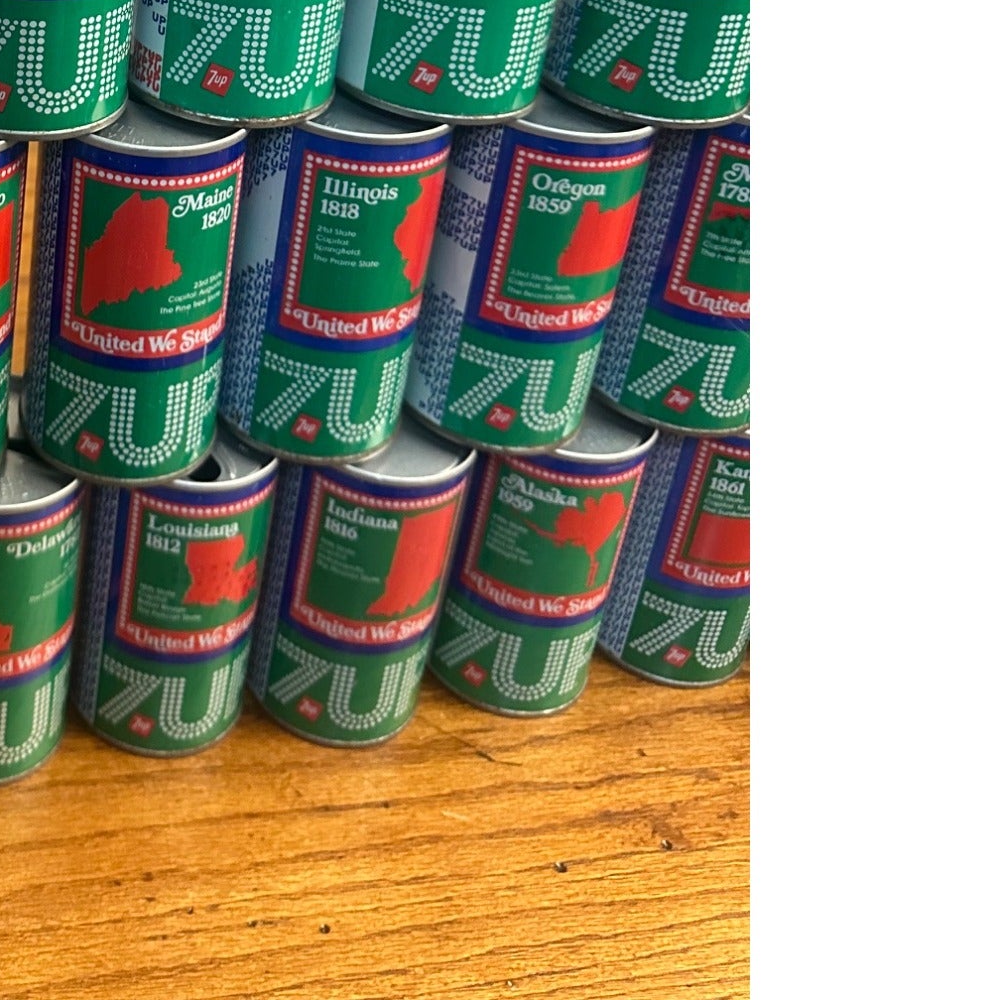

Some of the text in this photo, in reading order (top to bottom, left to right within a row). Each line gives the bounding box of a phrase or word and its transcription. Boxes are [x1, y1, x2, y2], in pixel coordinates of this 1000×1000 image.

[207, 69, 229, 88] 7up
[615, 65, 636, 82] 7up
[322, 176, 399, 205] Illinois
[532, 173, 606, 200] Oregon
[172, 185, 233, 218] Maine
[320, 199, 360, 220] 1818
[527, 194, 572, 215] 1859
[201, 203, 232, 231] 1820
[679, 285, 750, 315] United
[293, 308, 367, 338] United
[371, 308, 397, 332] We
[494, 301, 568, 330] United
[571, 298, 597, 324] We
[72, 315, 222, 354] United We Stand
[501, 473, 578, 508] Alaska
[709, 477, 746, 496] 1861
[148, 512, 240, 539] Louisiana
[326, 496, 399, 531] Indiana
[324, 516, 359, 541] 1816
[145, 533, 181, 554] 1812
[674, 560, 742, 587] United
[299, 605, 368, 641] United
[126, 625, 195, 652] United
